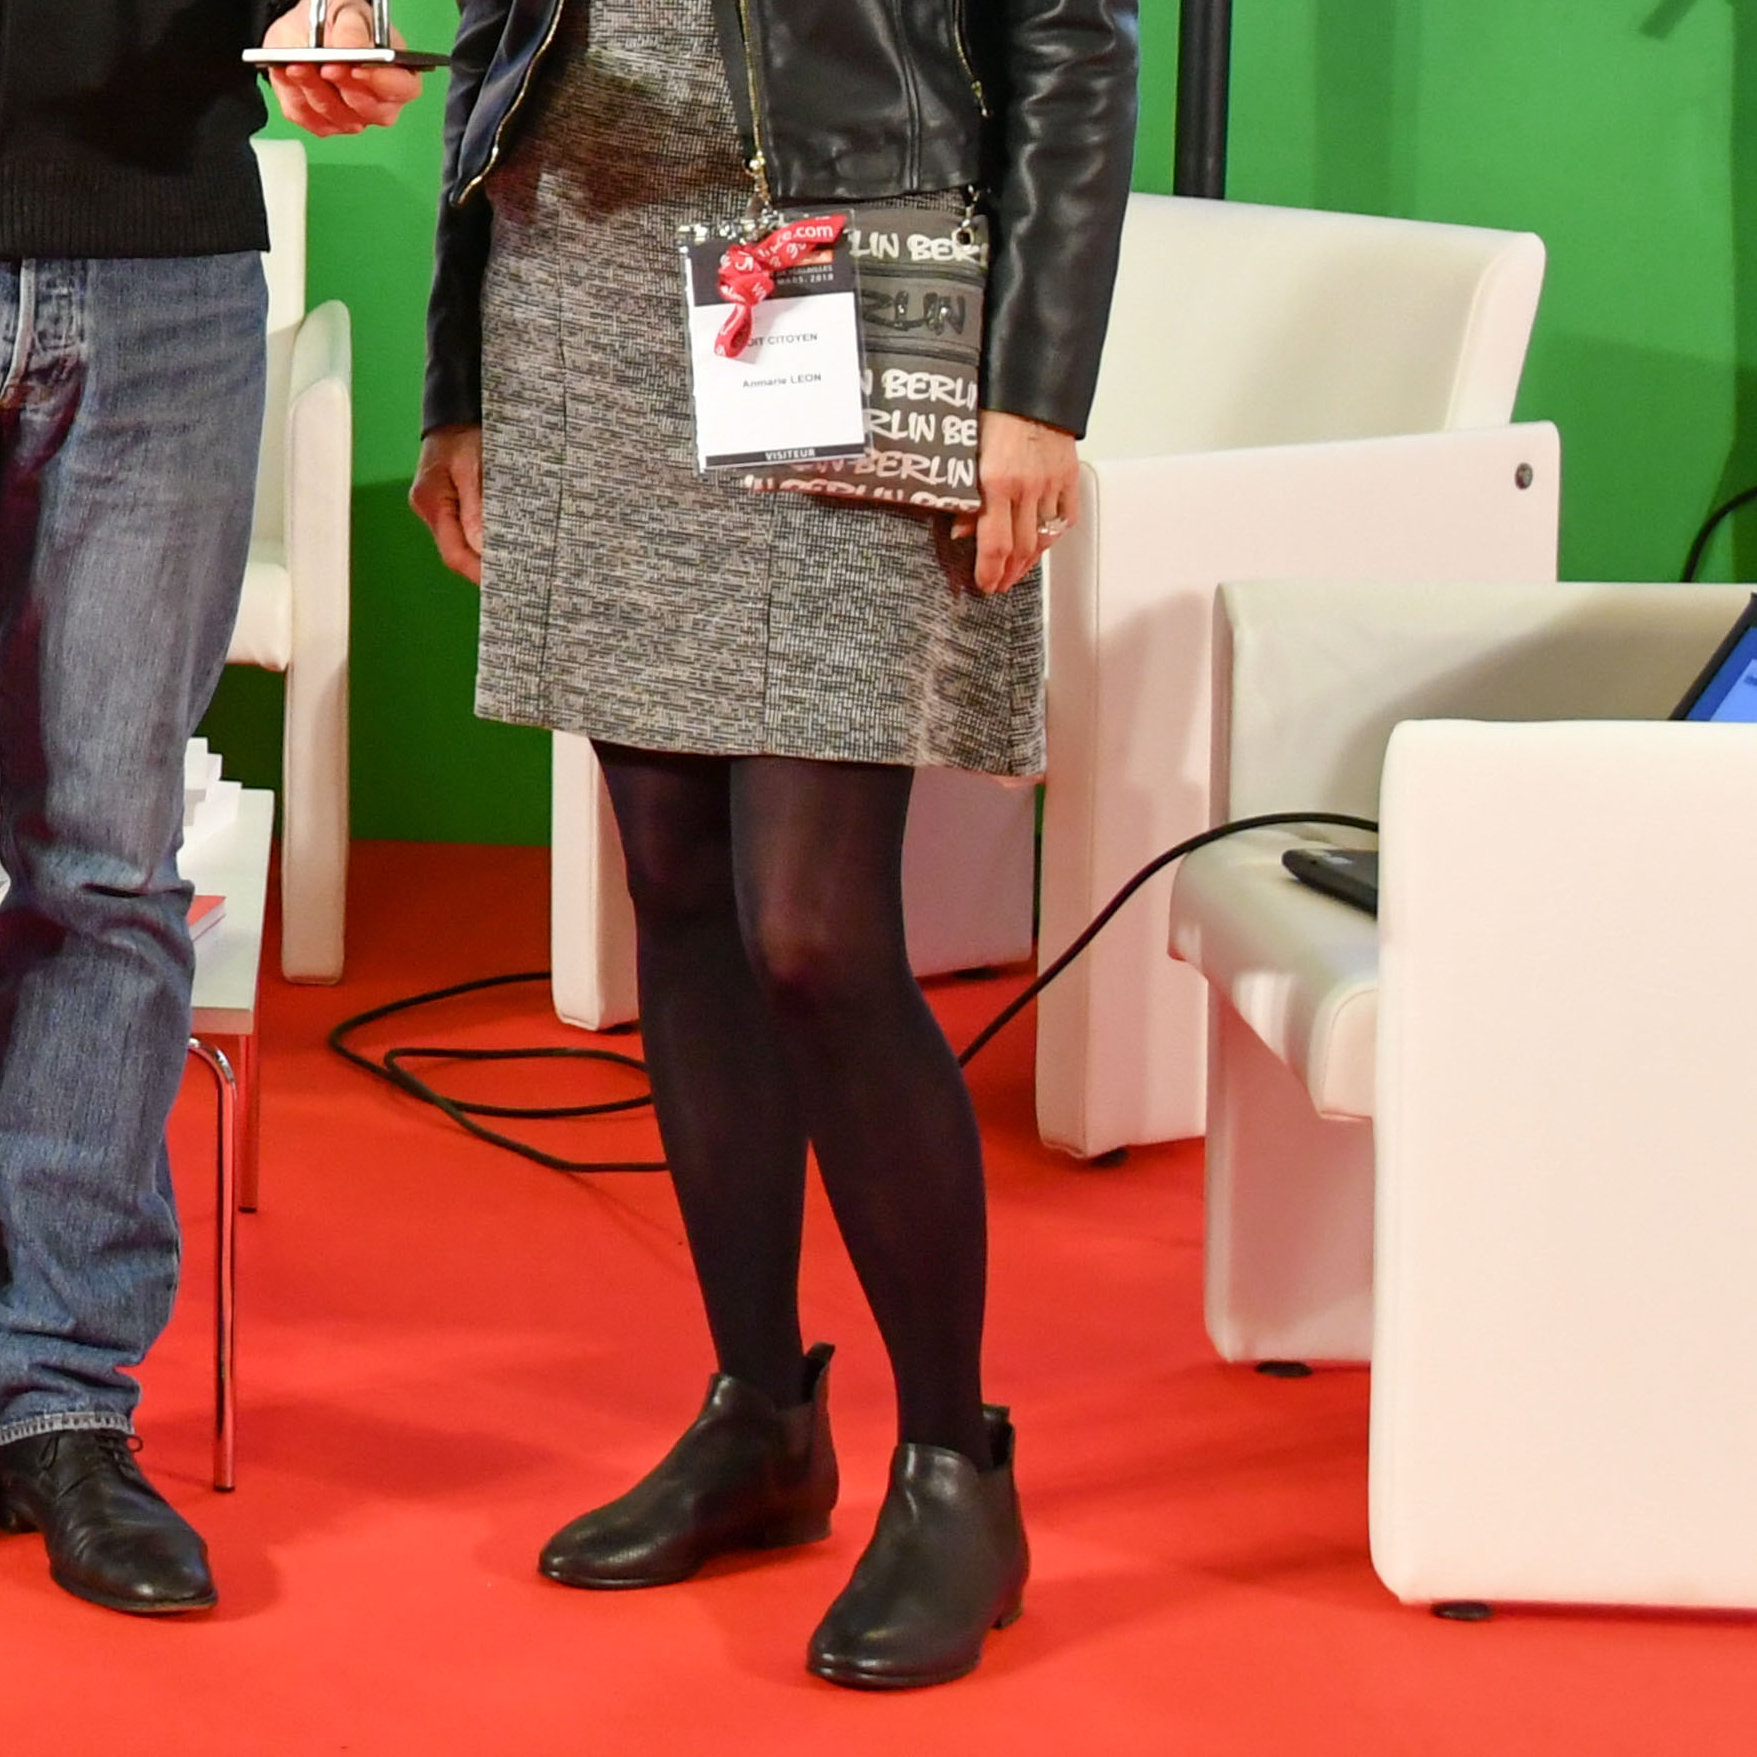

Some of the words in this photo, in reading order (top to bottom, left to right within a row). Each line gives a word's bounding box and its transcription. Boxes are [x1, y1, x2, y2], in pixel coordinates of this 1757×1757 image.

[768, 333, 818, 346] CITOYEN
[790, 373, 822, 384] LEON
[765, 448, 816, 462] VISITEUR
